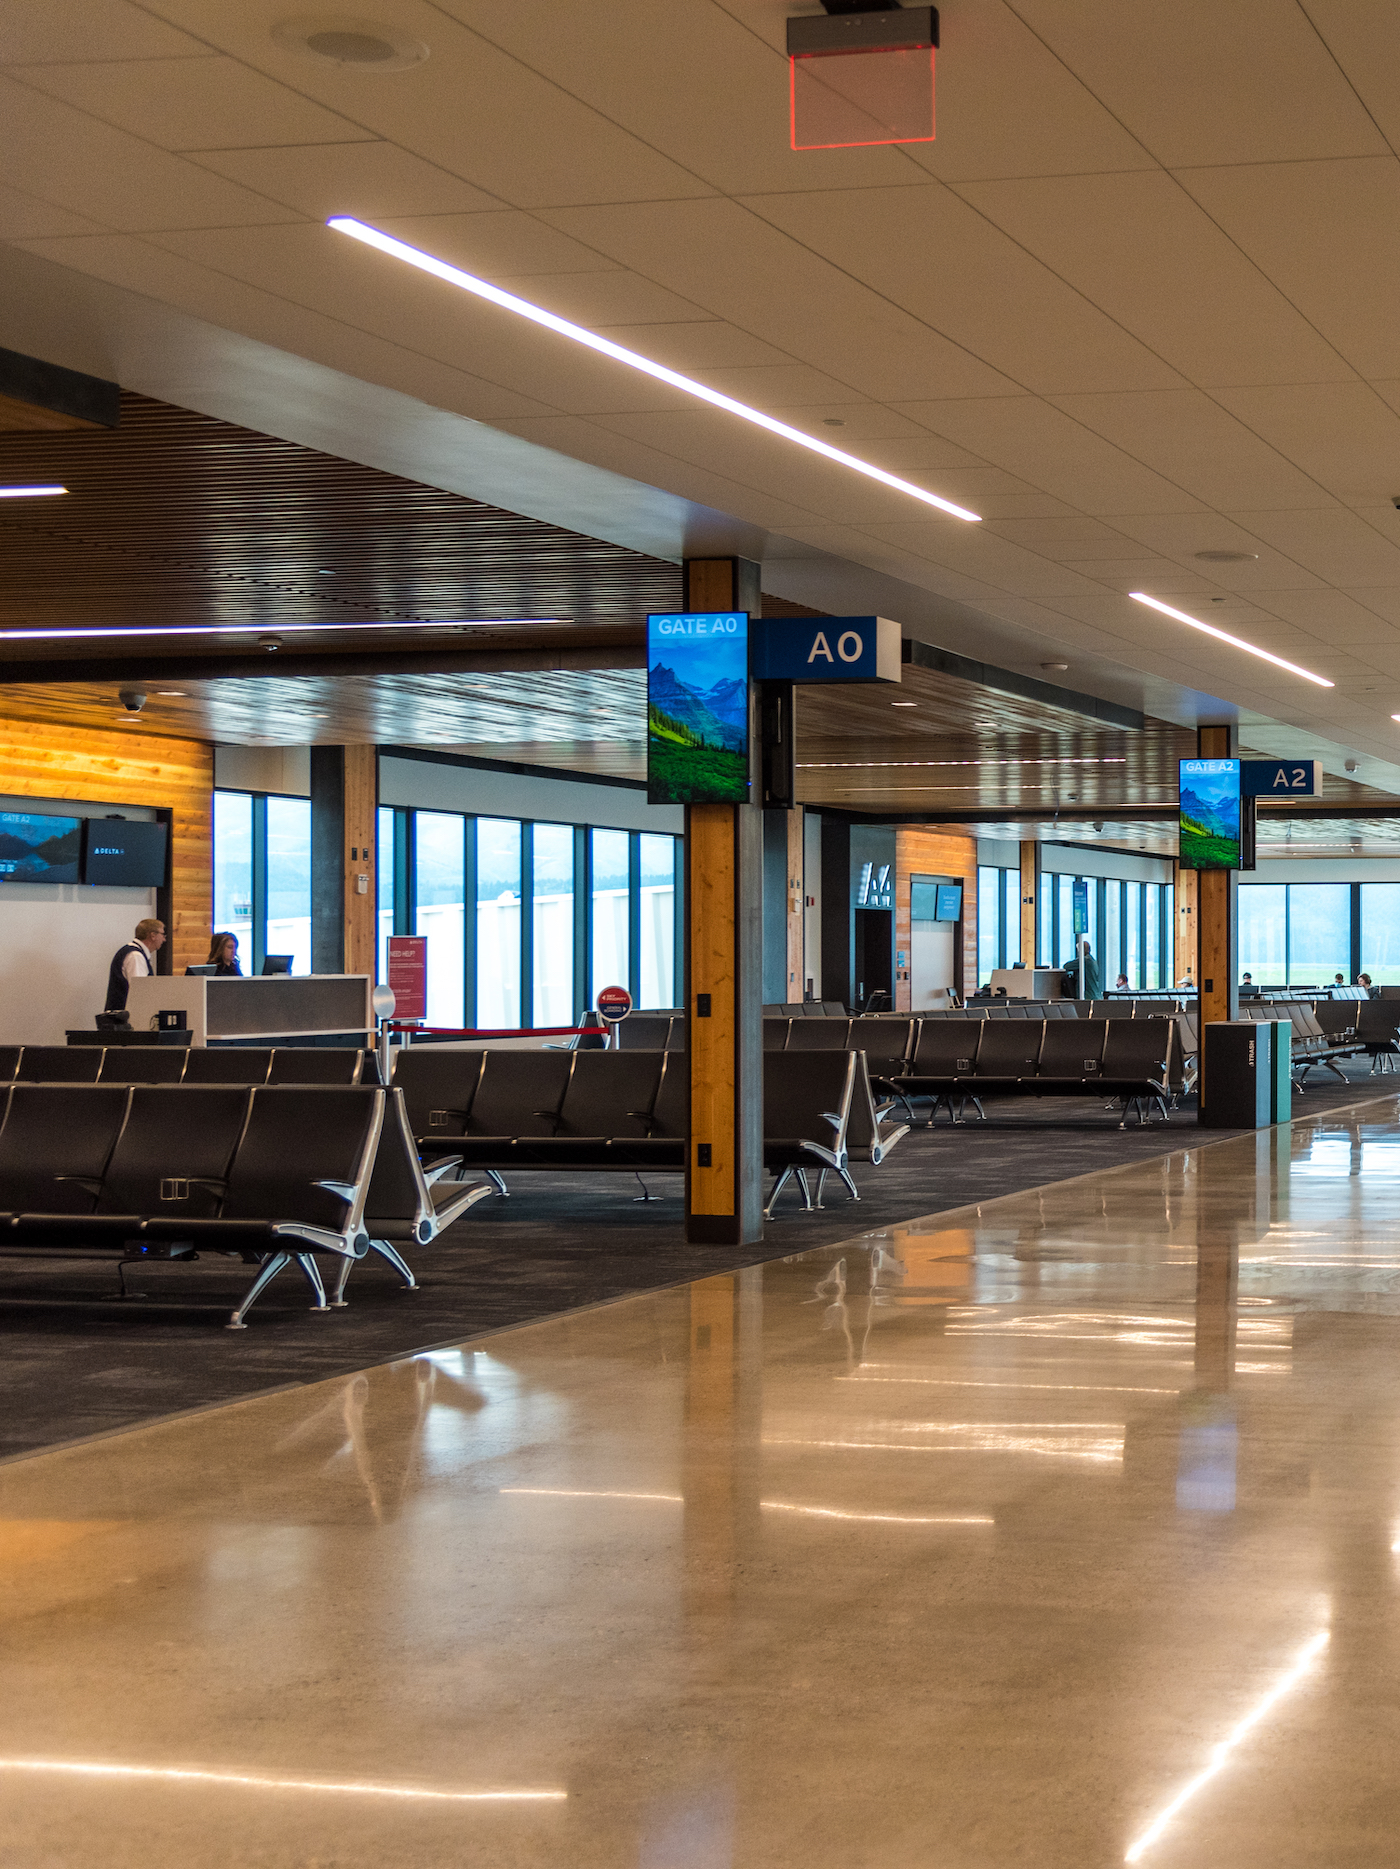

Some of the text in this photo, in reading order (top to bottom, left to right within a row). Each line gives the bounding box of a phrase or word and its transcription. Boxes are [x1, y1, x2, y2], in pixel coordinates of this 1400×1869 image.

[658, 617, 738, 635] GATE A0
[1186, 761, 1234, 772] GATE A2
[1272, 768, 1307, 788] A2
[1, 814, 20, 823] GATE
